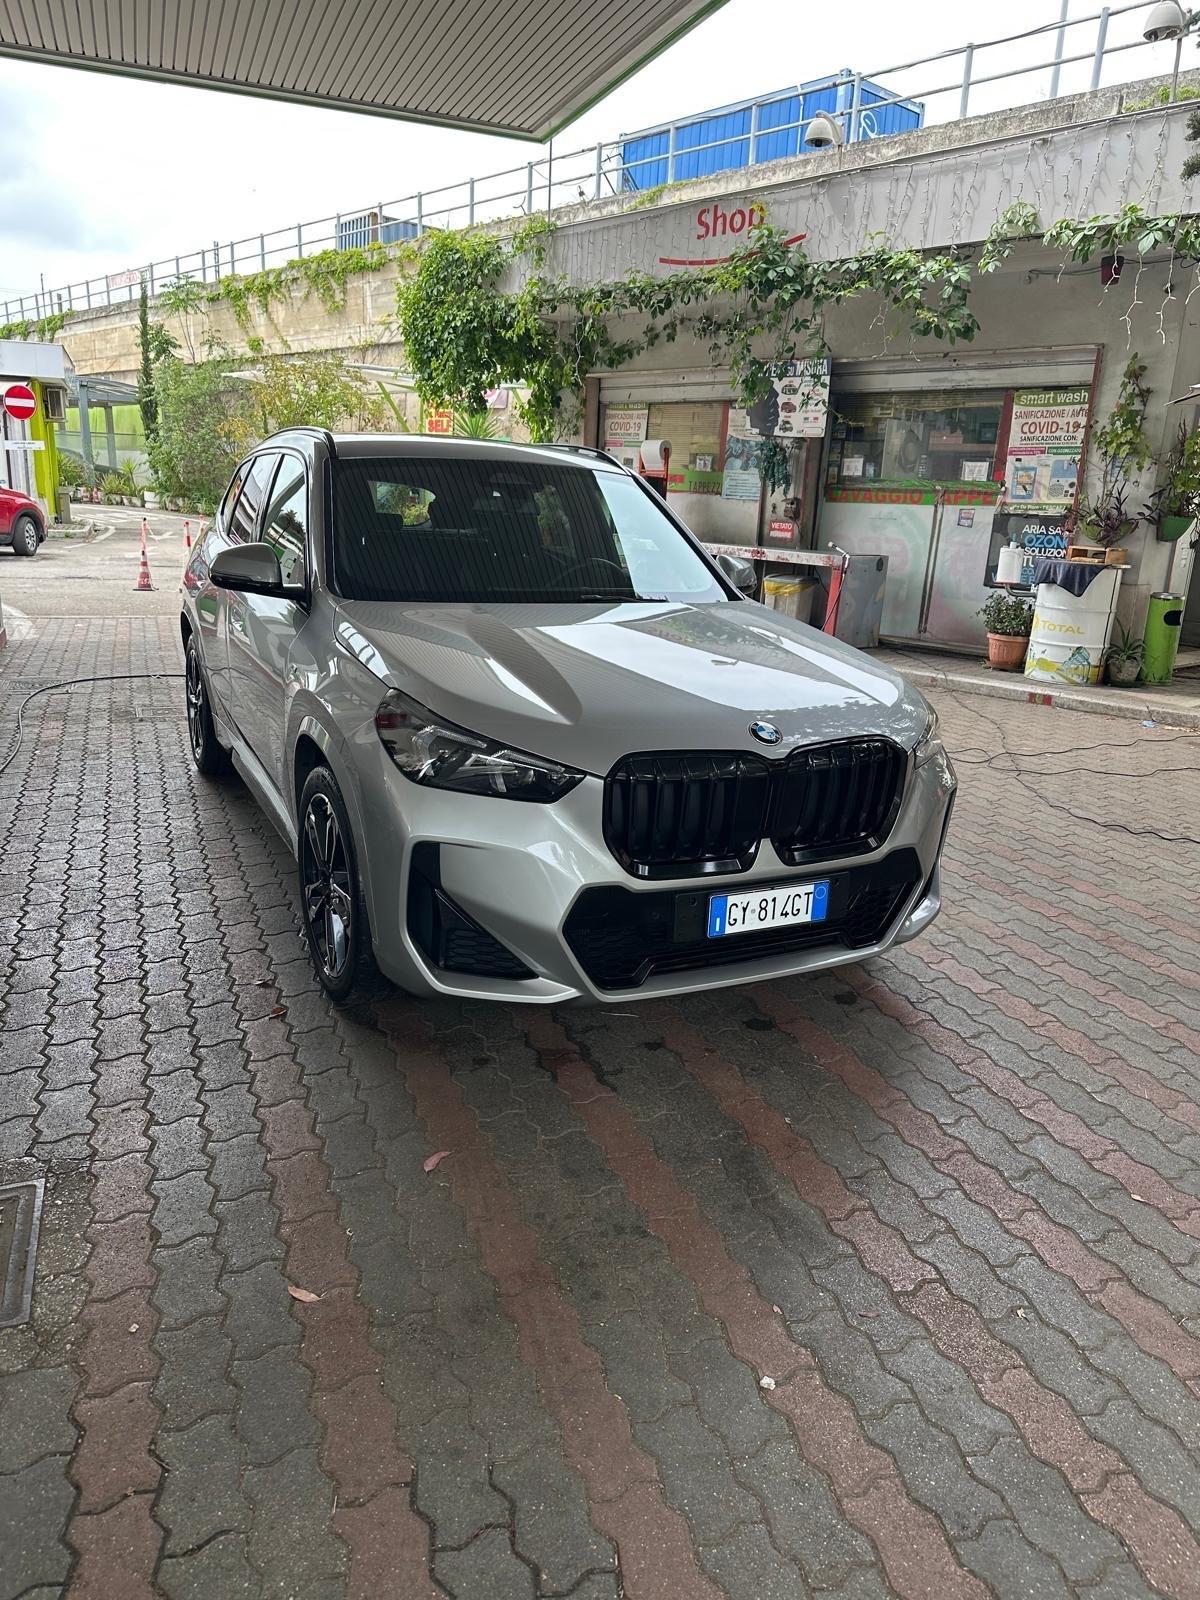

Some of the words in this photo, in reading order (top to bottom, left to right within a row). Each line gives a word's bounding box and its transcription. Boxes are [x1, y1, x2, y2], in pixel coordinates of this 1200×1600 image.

[697, 204, 765, 239] Shop
[1021, 392, 1054, 404] smart
[1057, 390, 1089, 402] wash
[1014, 409, 1066, 419] SANIFICAZIONE
[609, 421, 641, 431] COVID-19
[1021, 421, 1079, 434] COVID-19
[829, 488, 923, 504] LAVAGGIO
[1022, 525, 1047, 534] ARIA
[1041, 620, 1085, 635] TOTAL
[728, 901, 749, 926] GY
[758, 892, 813, 921] 814GT
